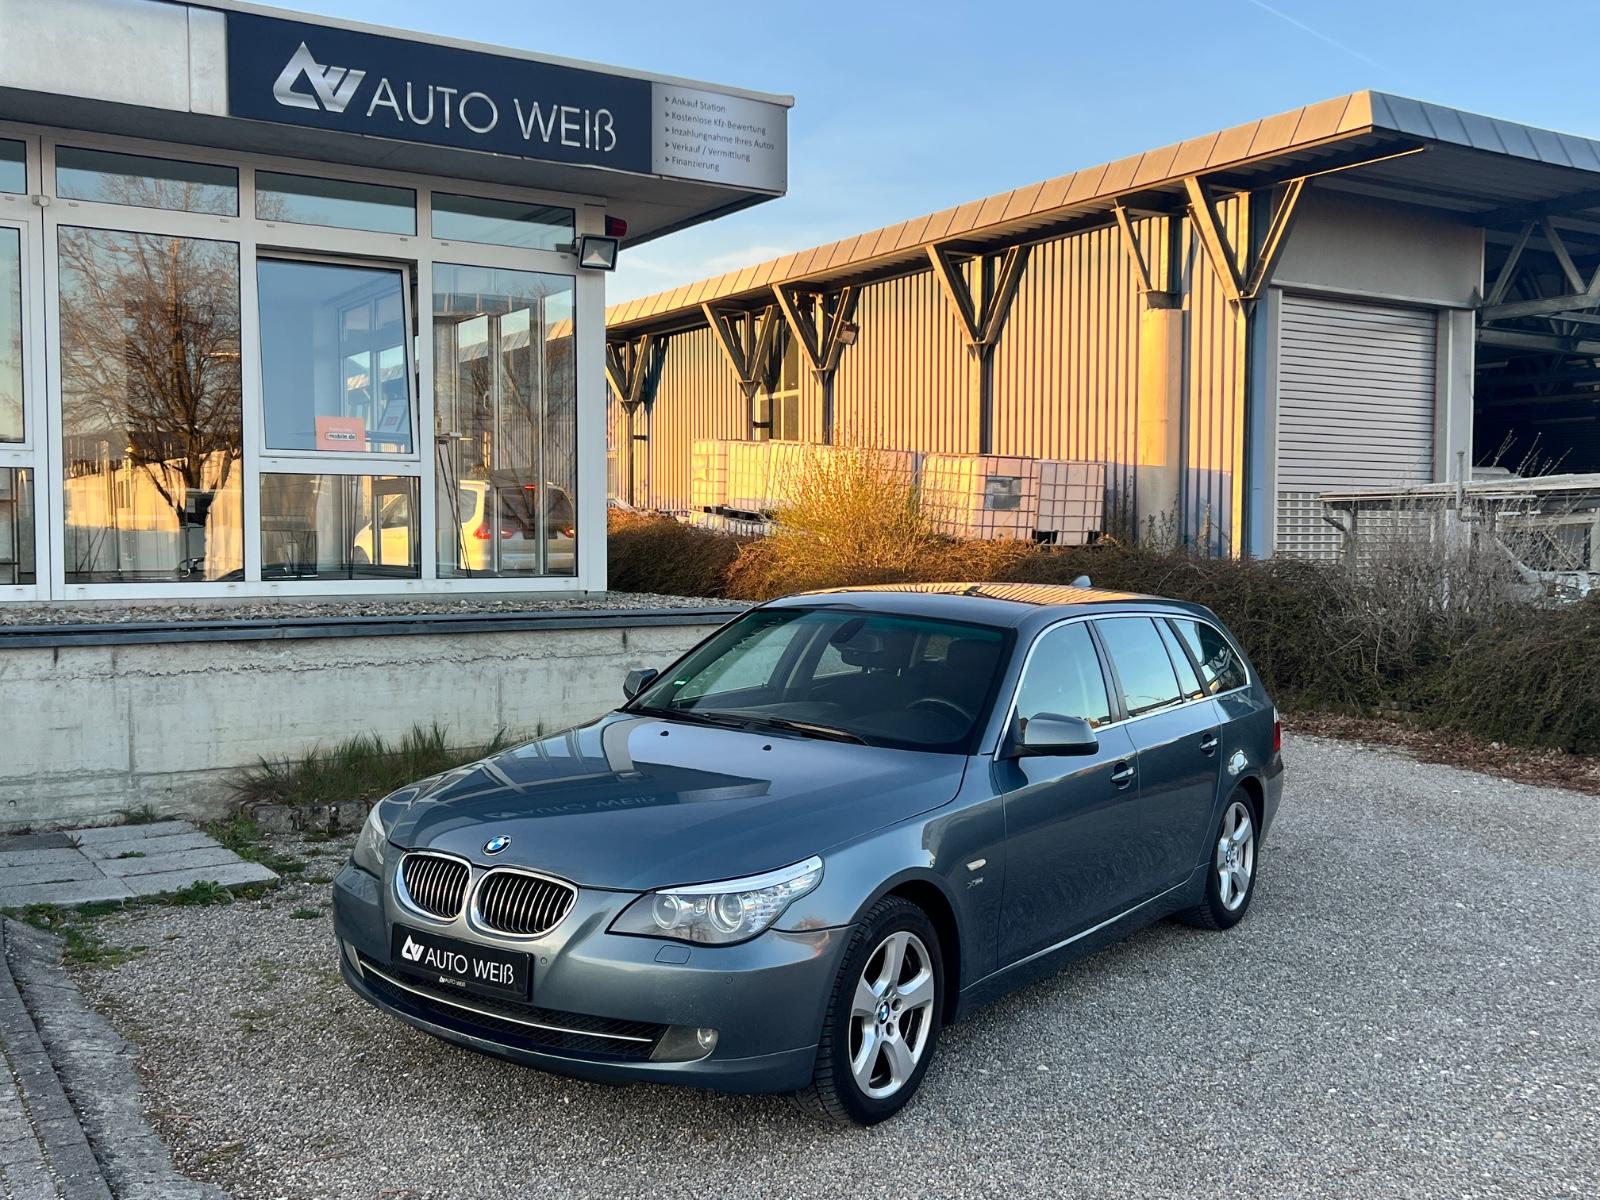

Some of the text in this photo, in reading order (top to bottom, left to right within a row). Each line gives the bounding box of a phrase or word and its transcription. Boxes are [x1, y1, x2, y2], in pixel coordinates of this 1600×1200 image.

[366, 78, 498, 134] AUTO
[514, 98, 617, 152] WEIß
[671, 97, 726, 112] Ankauf Station
[671, 112, 767, 136] Kostenlose Kfz-Bewertung
[671, 127, 775, 150] Inzahlungnahme Ihres Autos
[671, 142, 701, 153] Verkauf
[708, 147, 751, 162] Vermittlung
[671, 156, 720, 172] Finanzierung
[425, 947, 468, 974] AUTO
[473, 958, 514, 985] WEIß
